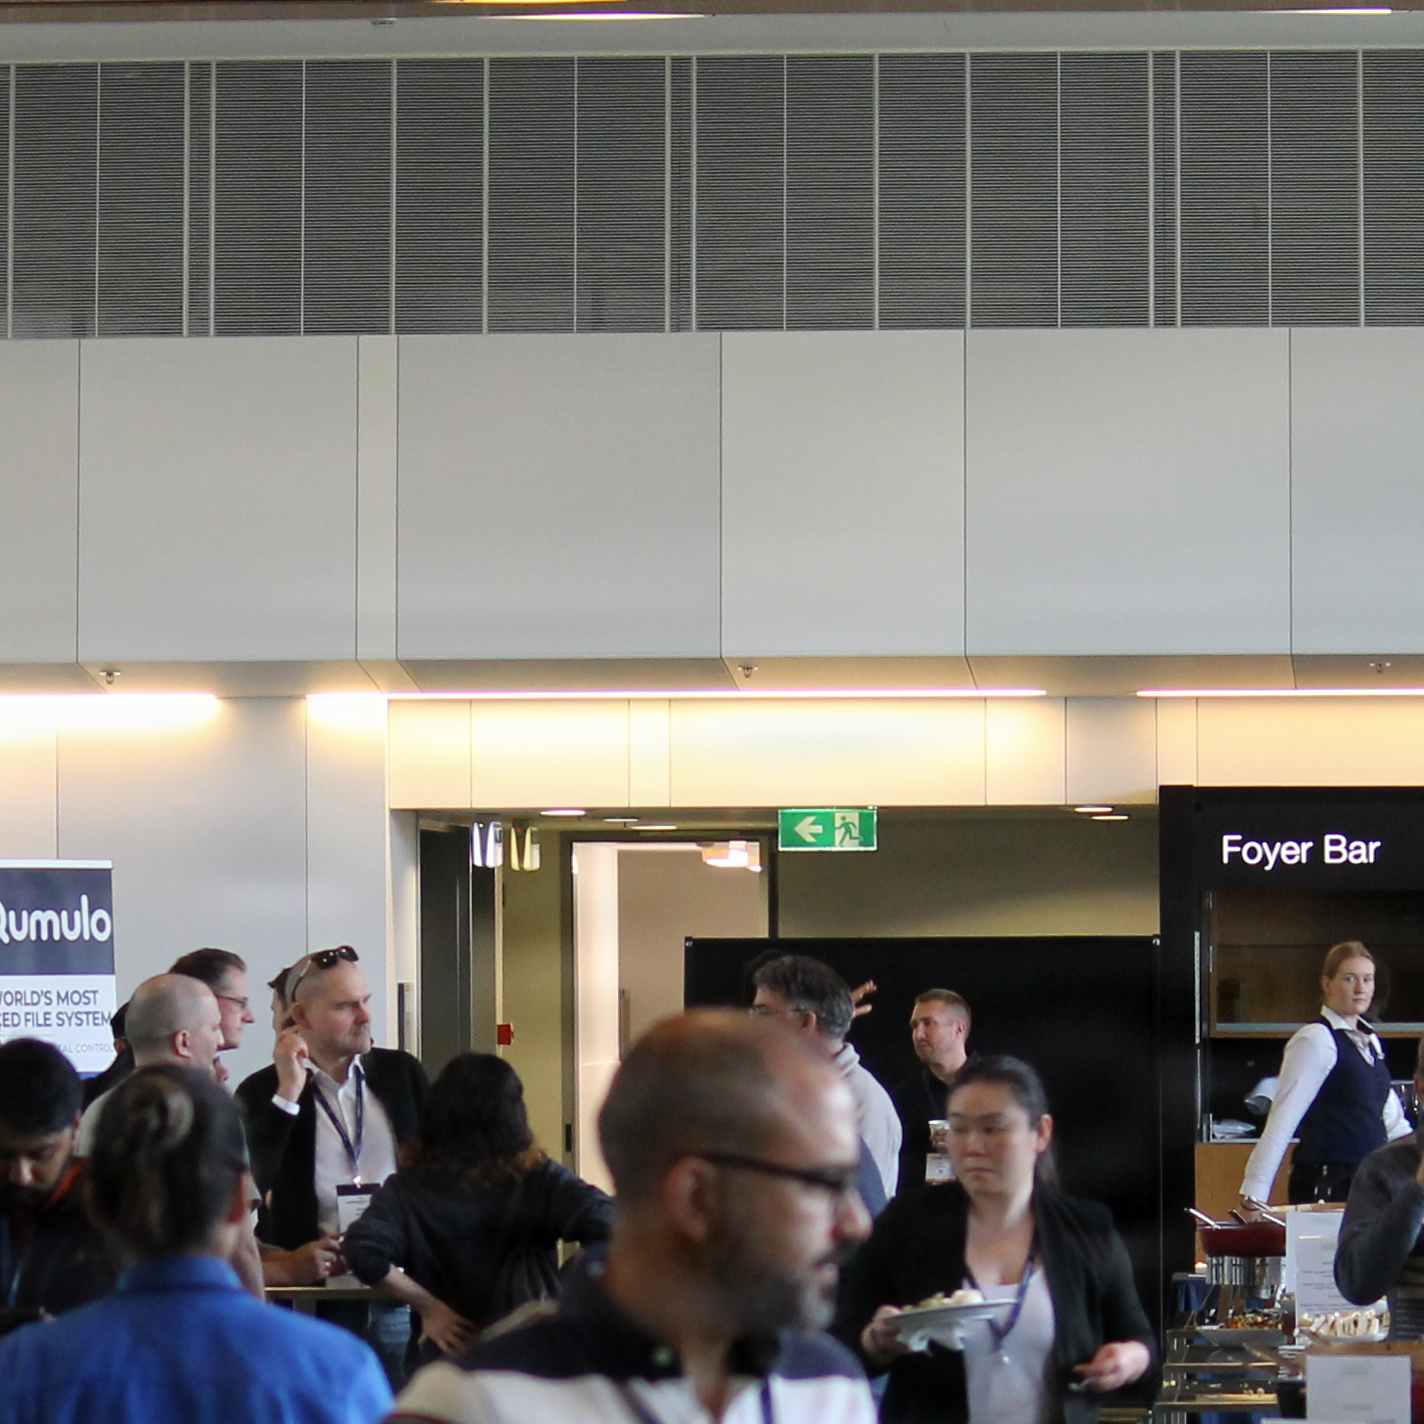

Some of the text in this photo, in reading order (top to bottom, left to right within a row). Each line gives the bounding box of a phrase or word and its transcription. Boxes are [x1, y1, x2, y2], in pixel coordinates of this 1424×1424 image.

[1222, 834, 1382, 871] Foyer Bar
[56, 989, 99, 1006] MOST
[25, 1012, 53, 1027] FILE
